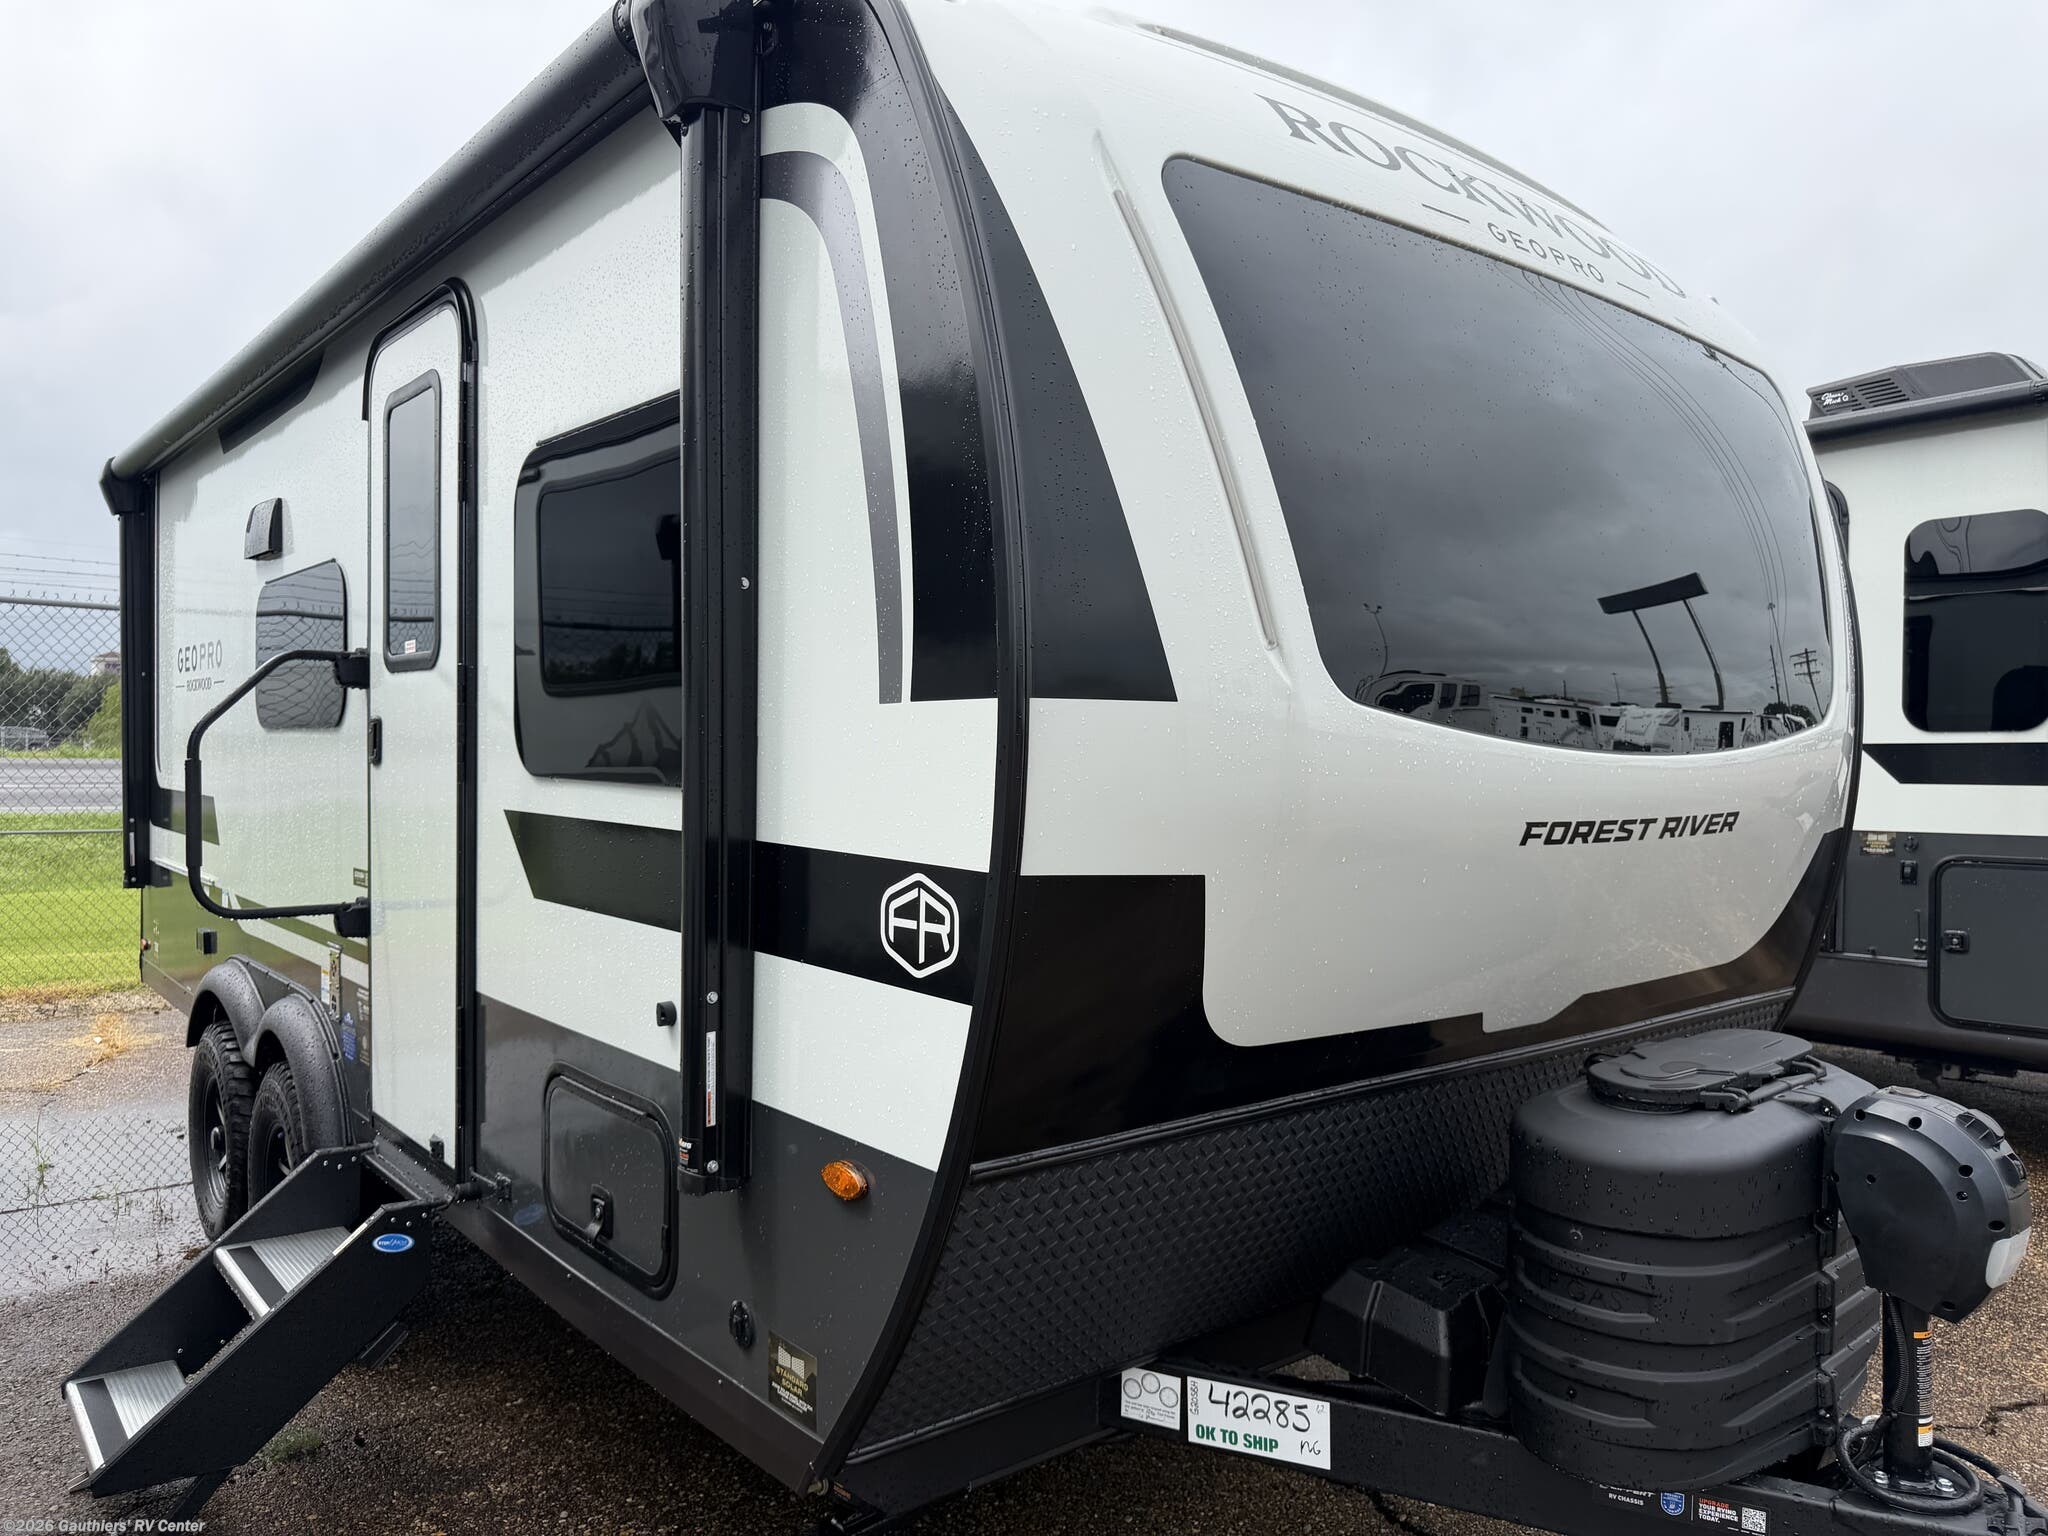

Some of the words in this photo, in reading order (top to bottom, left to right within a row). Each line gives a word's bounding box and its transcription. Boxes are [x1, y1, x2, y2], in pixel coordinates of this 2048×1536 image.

[1254, 93, 1687, 298] ROCKWOOD
[1487, 221, 1605, 283] GEOPRO
[1519, 817, 1659, 846] FOREST
[1658, 811, 1740, 839] RIVER
[1208, 1383, 1311, 1433] 42285
[1195, 1423, 1217, 1442] OK
[1220, 1428, 1239, 1446] TO
[1243, 1434, 1279, 1453] SHIP
[1608, 1492, 1618, 1500] RV
[1618, 1494, 1645, 1507] CHASSIS
